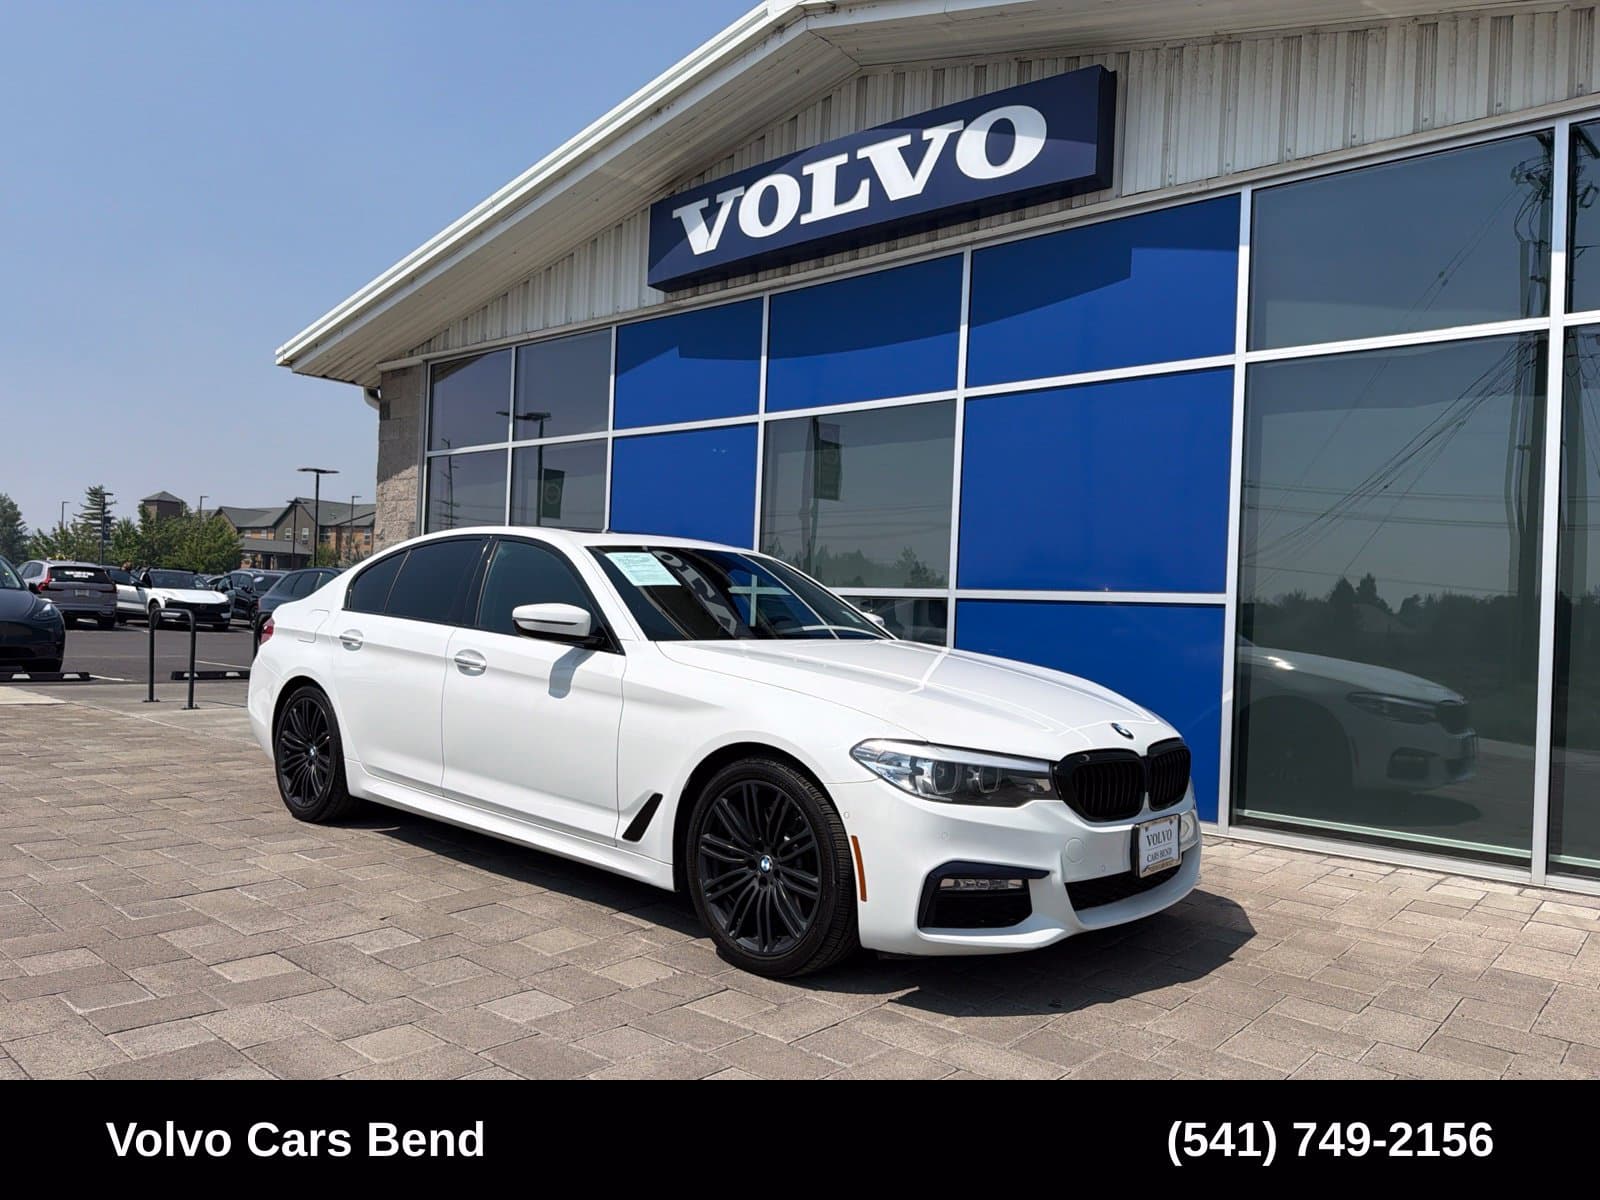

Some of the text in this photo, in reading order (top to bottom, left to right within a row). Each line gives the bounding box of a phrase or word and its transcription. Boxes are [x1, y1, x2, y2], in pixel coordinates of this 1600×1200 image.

[672, 104, 1048, 256] VOLVO
[1146, 828, 1173, 847] VOLVO
[1147, 851, 1160, 863] CARS
